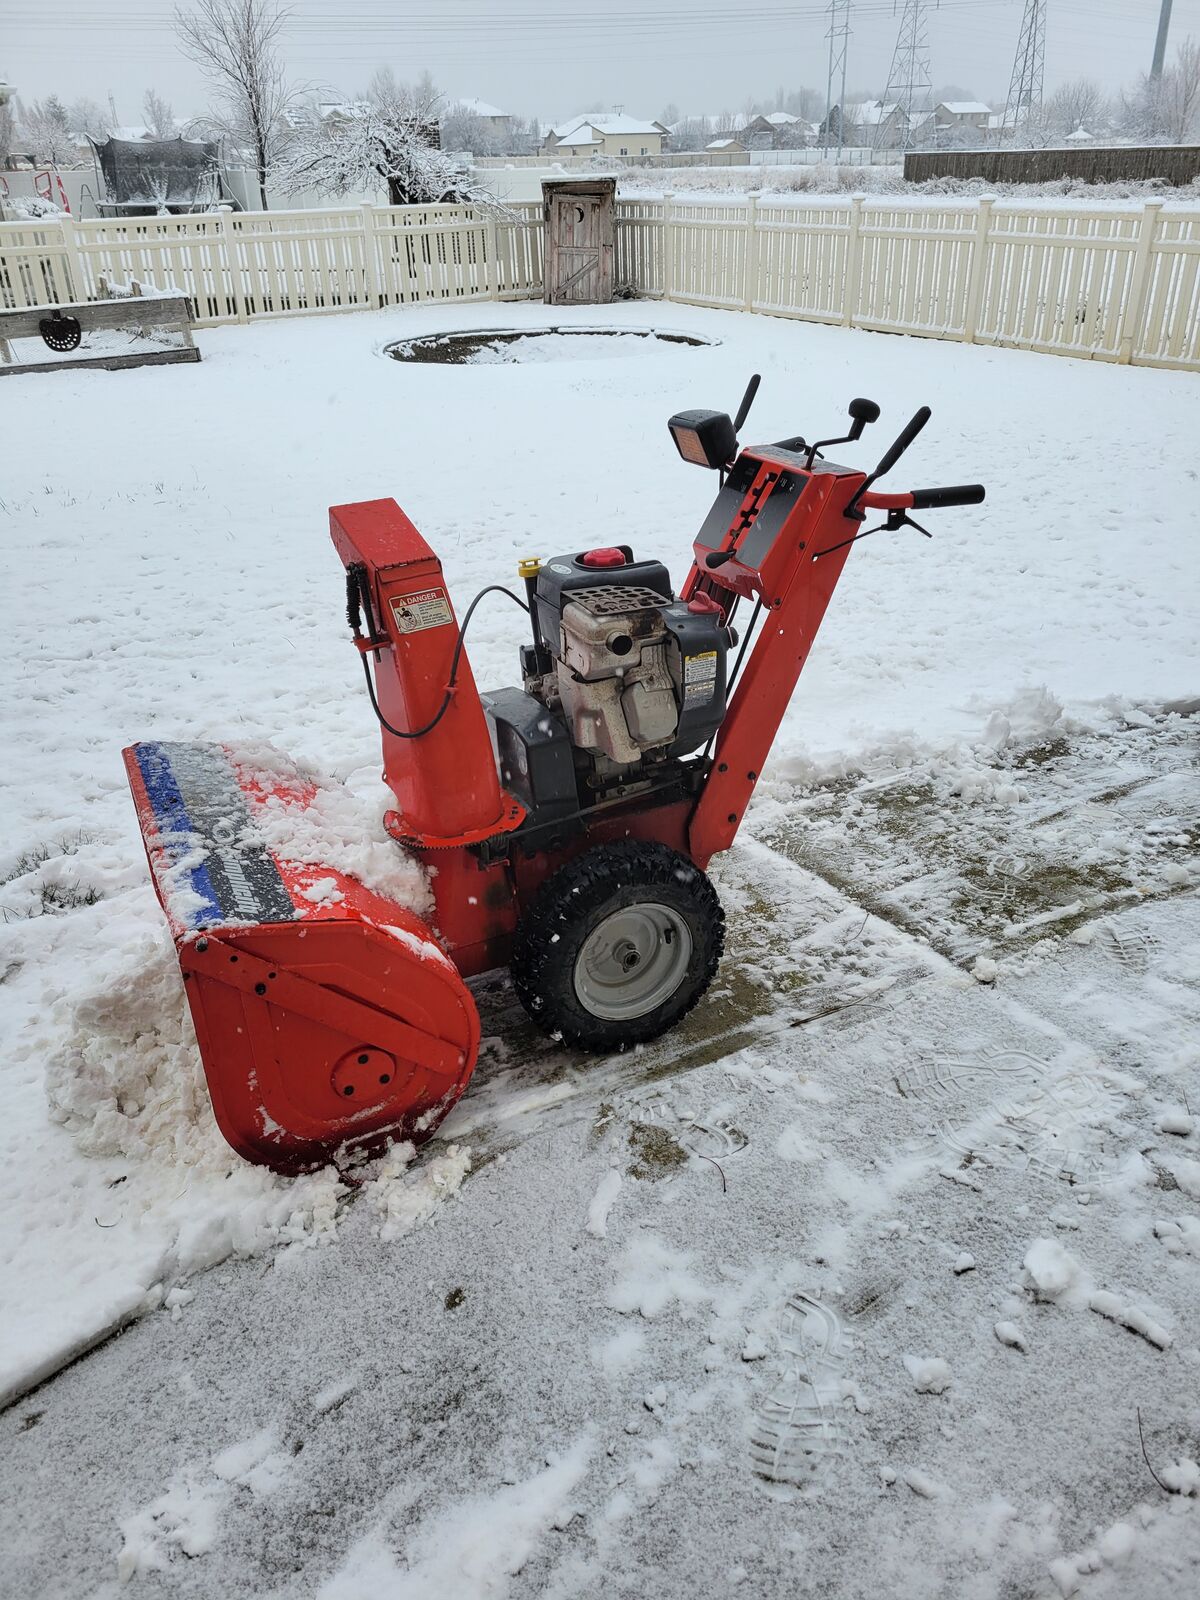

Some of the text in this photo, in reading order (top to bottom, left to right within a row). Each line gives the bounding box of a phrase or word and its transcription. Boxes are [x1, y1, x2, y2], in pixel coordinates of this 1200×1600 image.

[407, 592, 437, 604] DANGER
[609, 603, 638, 611] HOT
[219, 853, 262, 914] implicity
